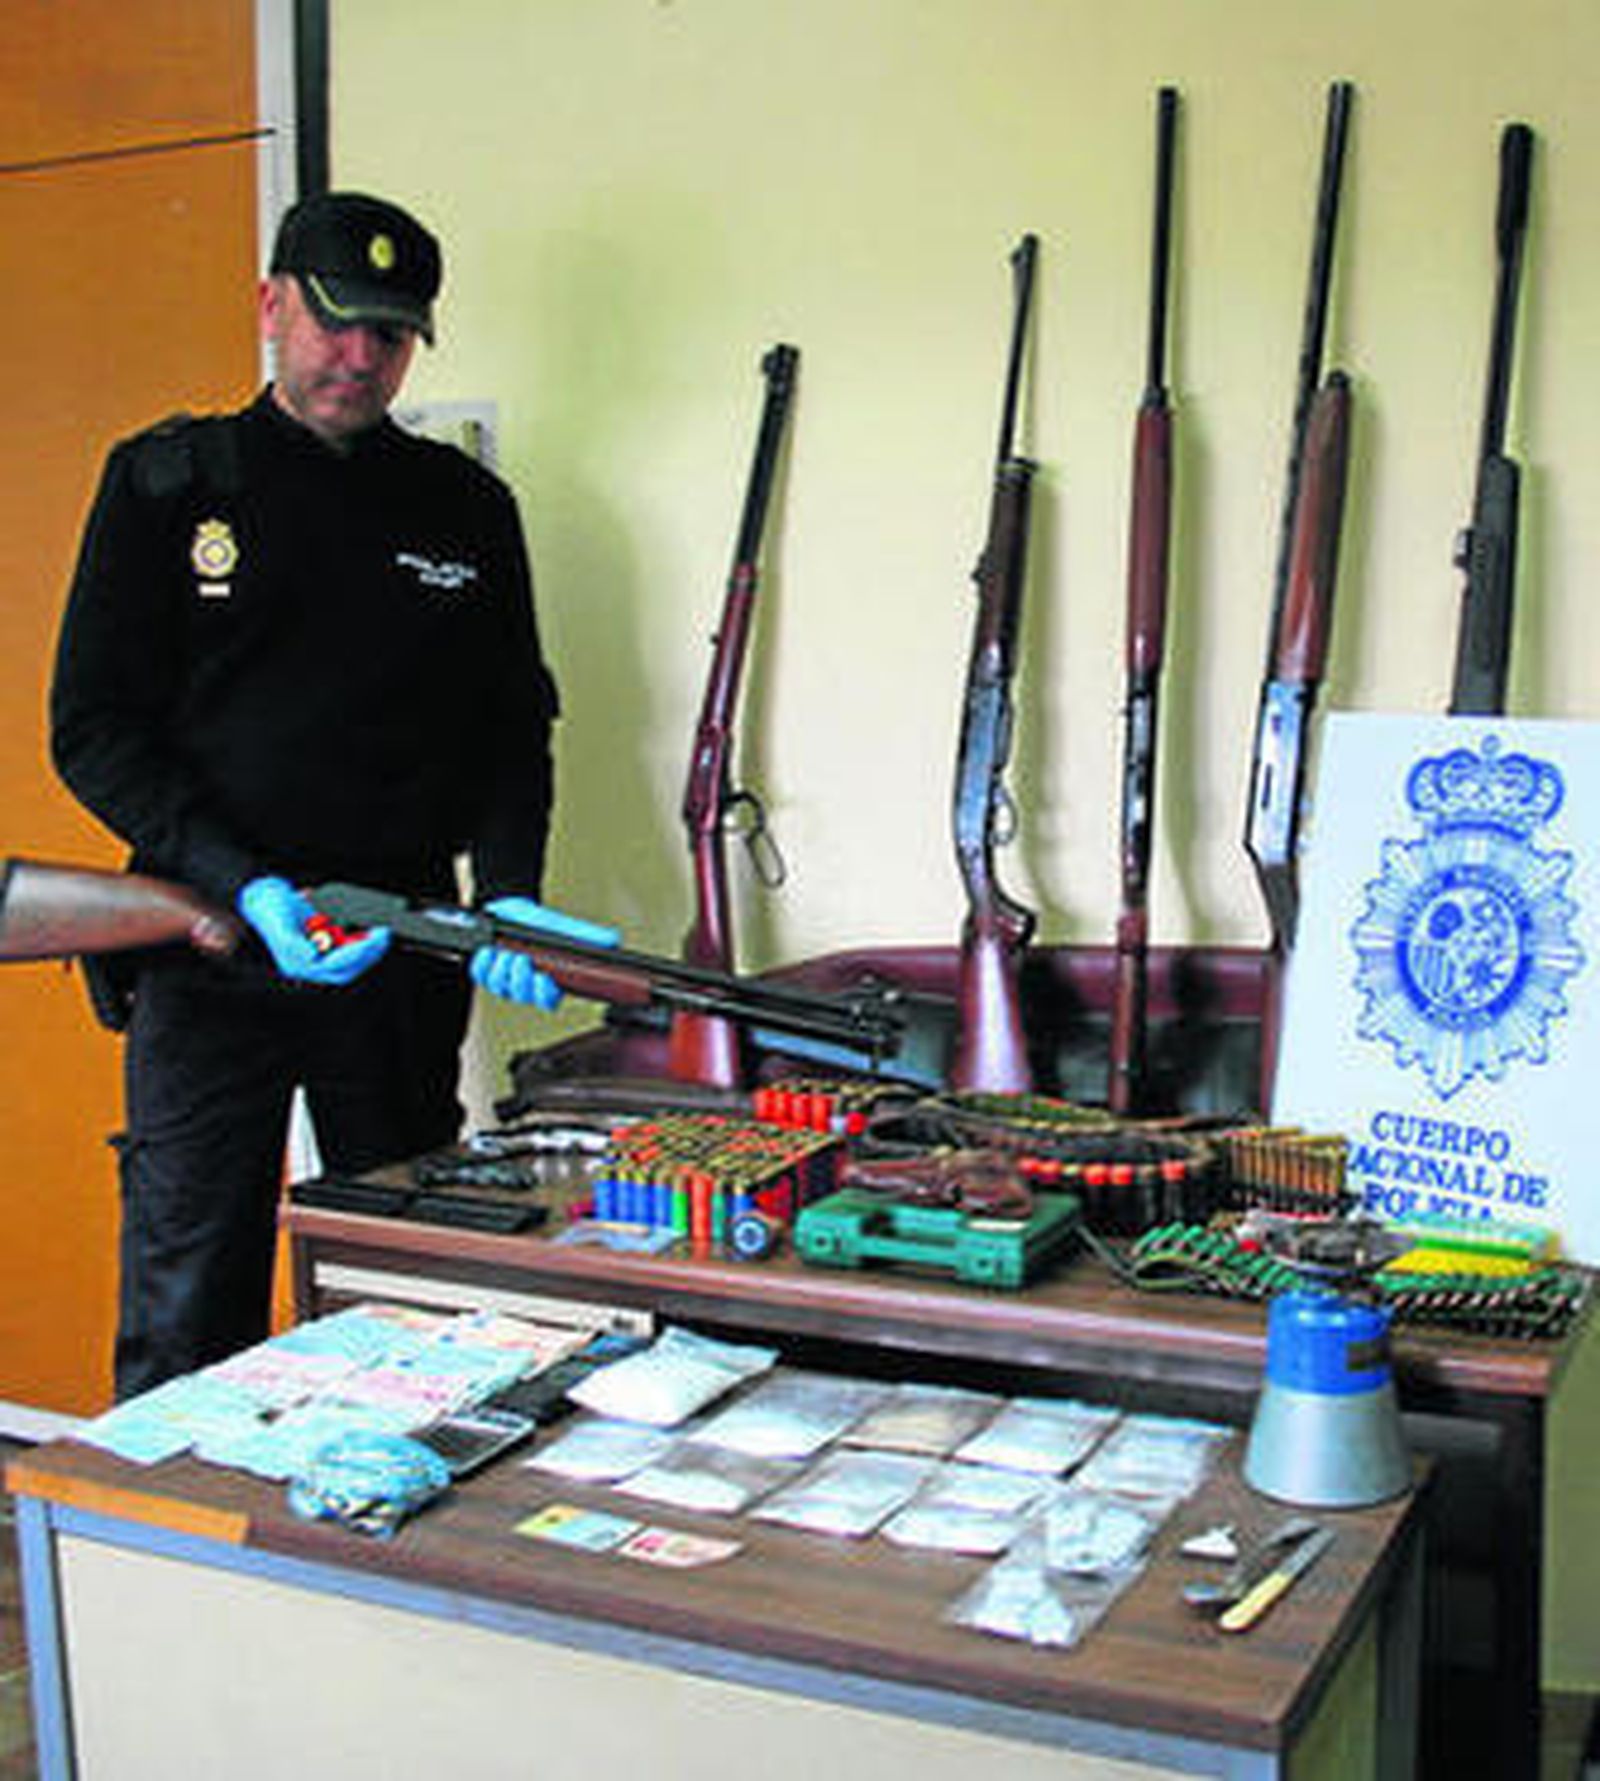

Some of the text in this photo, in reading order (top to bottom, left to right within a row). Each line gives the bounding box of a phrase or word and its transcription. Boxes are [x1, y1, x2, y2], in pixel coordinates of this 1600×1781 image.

[1370, 1111, 1510, 1162] CUERPO
[1346, 1142, 1548, 1208] ACIONAL DE
